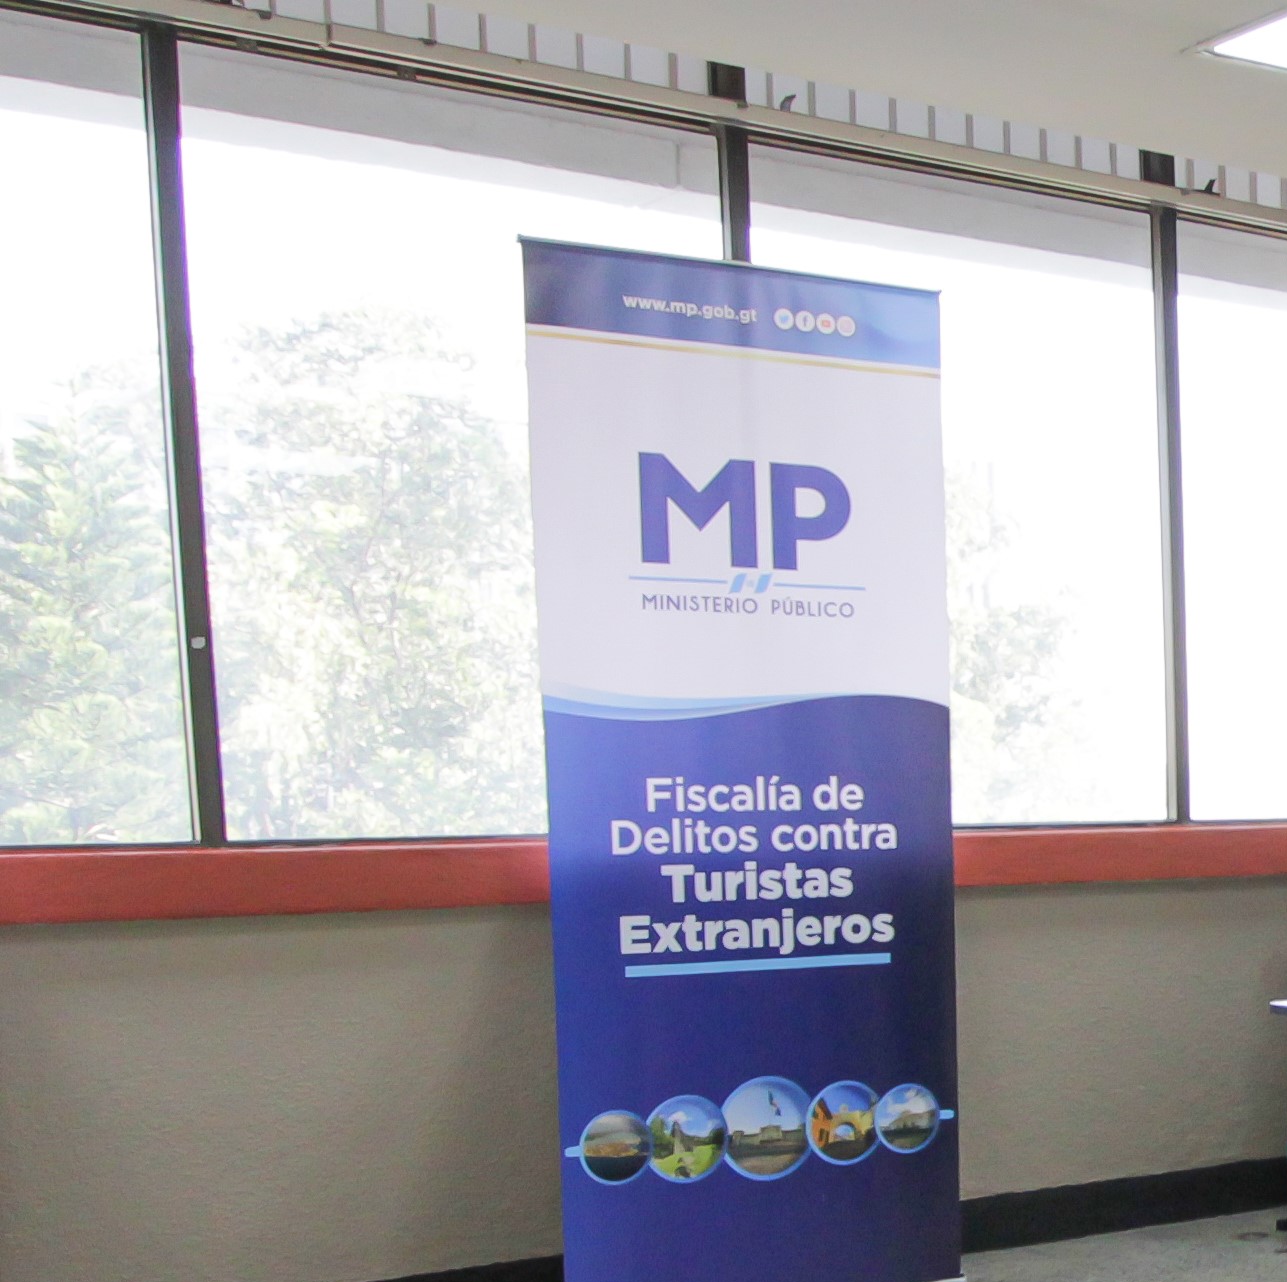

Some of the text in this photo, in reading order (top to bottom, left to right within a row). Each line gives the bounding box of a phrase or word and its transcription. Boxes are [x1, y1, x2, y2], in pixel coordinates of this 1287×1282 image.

[622, 294, 757, 324] www.mp.gob.gt
[638, 451, 852, 570] MP
[641, 593, 855, 618] MINISTERIO PÚBLICO
[646, 775, 864, 812] Fiscalía de
[610, 818, 898, 855] Delitos contra
[660, 861, 854, 903] Turistas
[620, 908, 896, 955] Extranjeros
